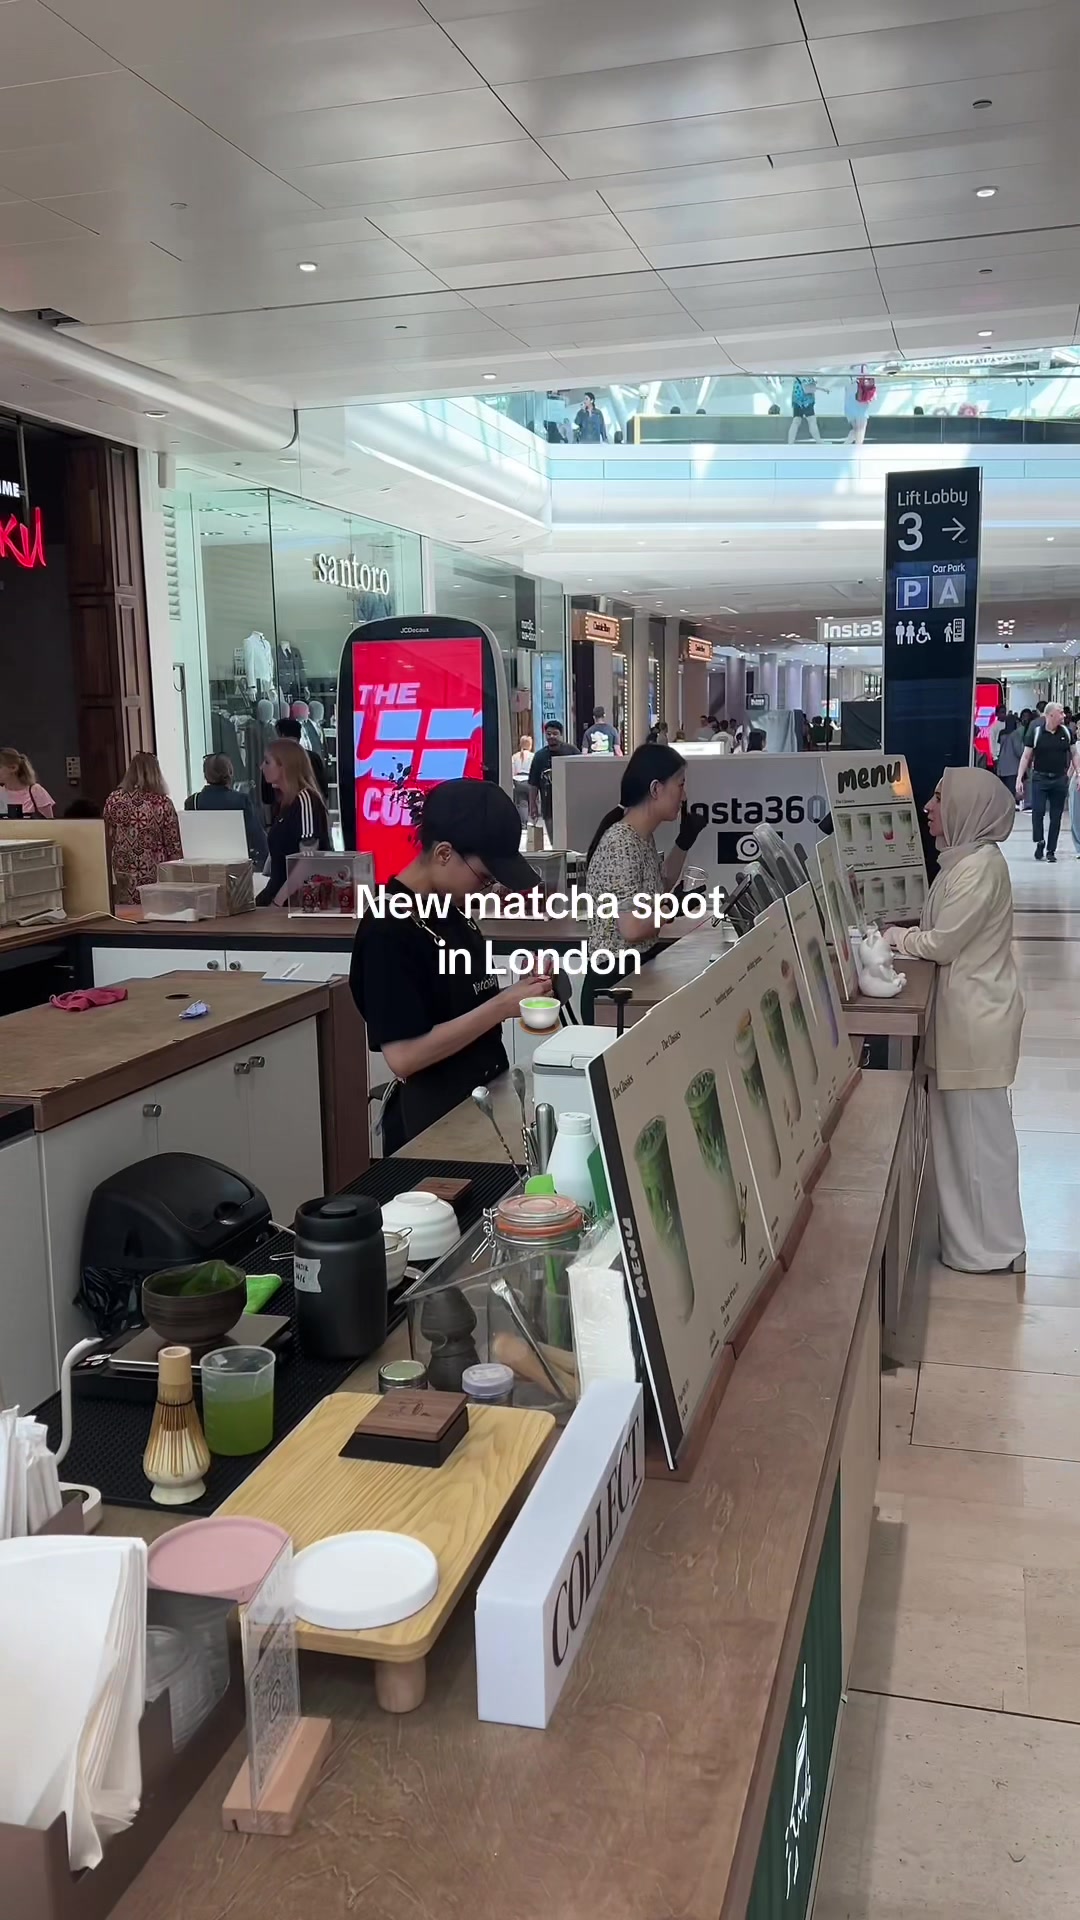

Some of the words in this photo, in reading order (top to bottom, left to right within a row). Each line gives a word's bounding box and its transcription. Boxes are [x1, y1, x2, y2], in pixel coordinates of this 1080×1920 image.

[898, 490, 921, 506] Lift
[924, 488, 968, 506] Lobby
[897, 511, 923, 552] 3
[318, 553, 390, 595] santoro
[932, 564, 946, 573] Car
[947, 562, 966, 573] Park
[903, 580, 922, 607] P
[938, 577, 959, 605] A
[358, 682, 421, 705] THE
[838, 761, 902, 794] menu
[622, 1217, 647, 1298] MENU
[552, 1416, 640, 1668] COLLECT
